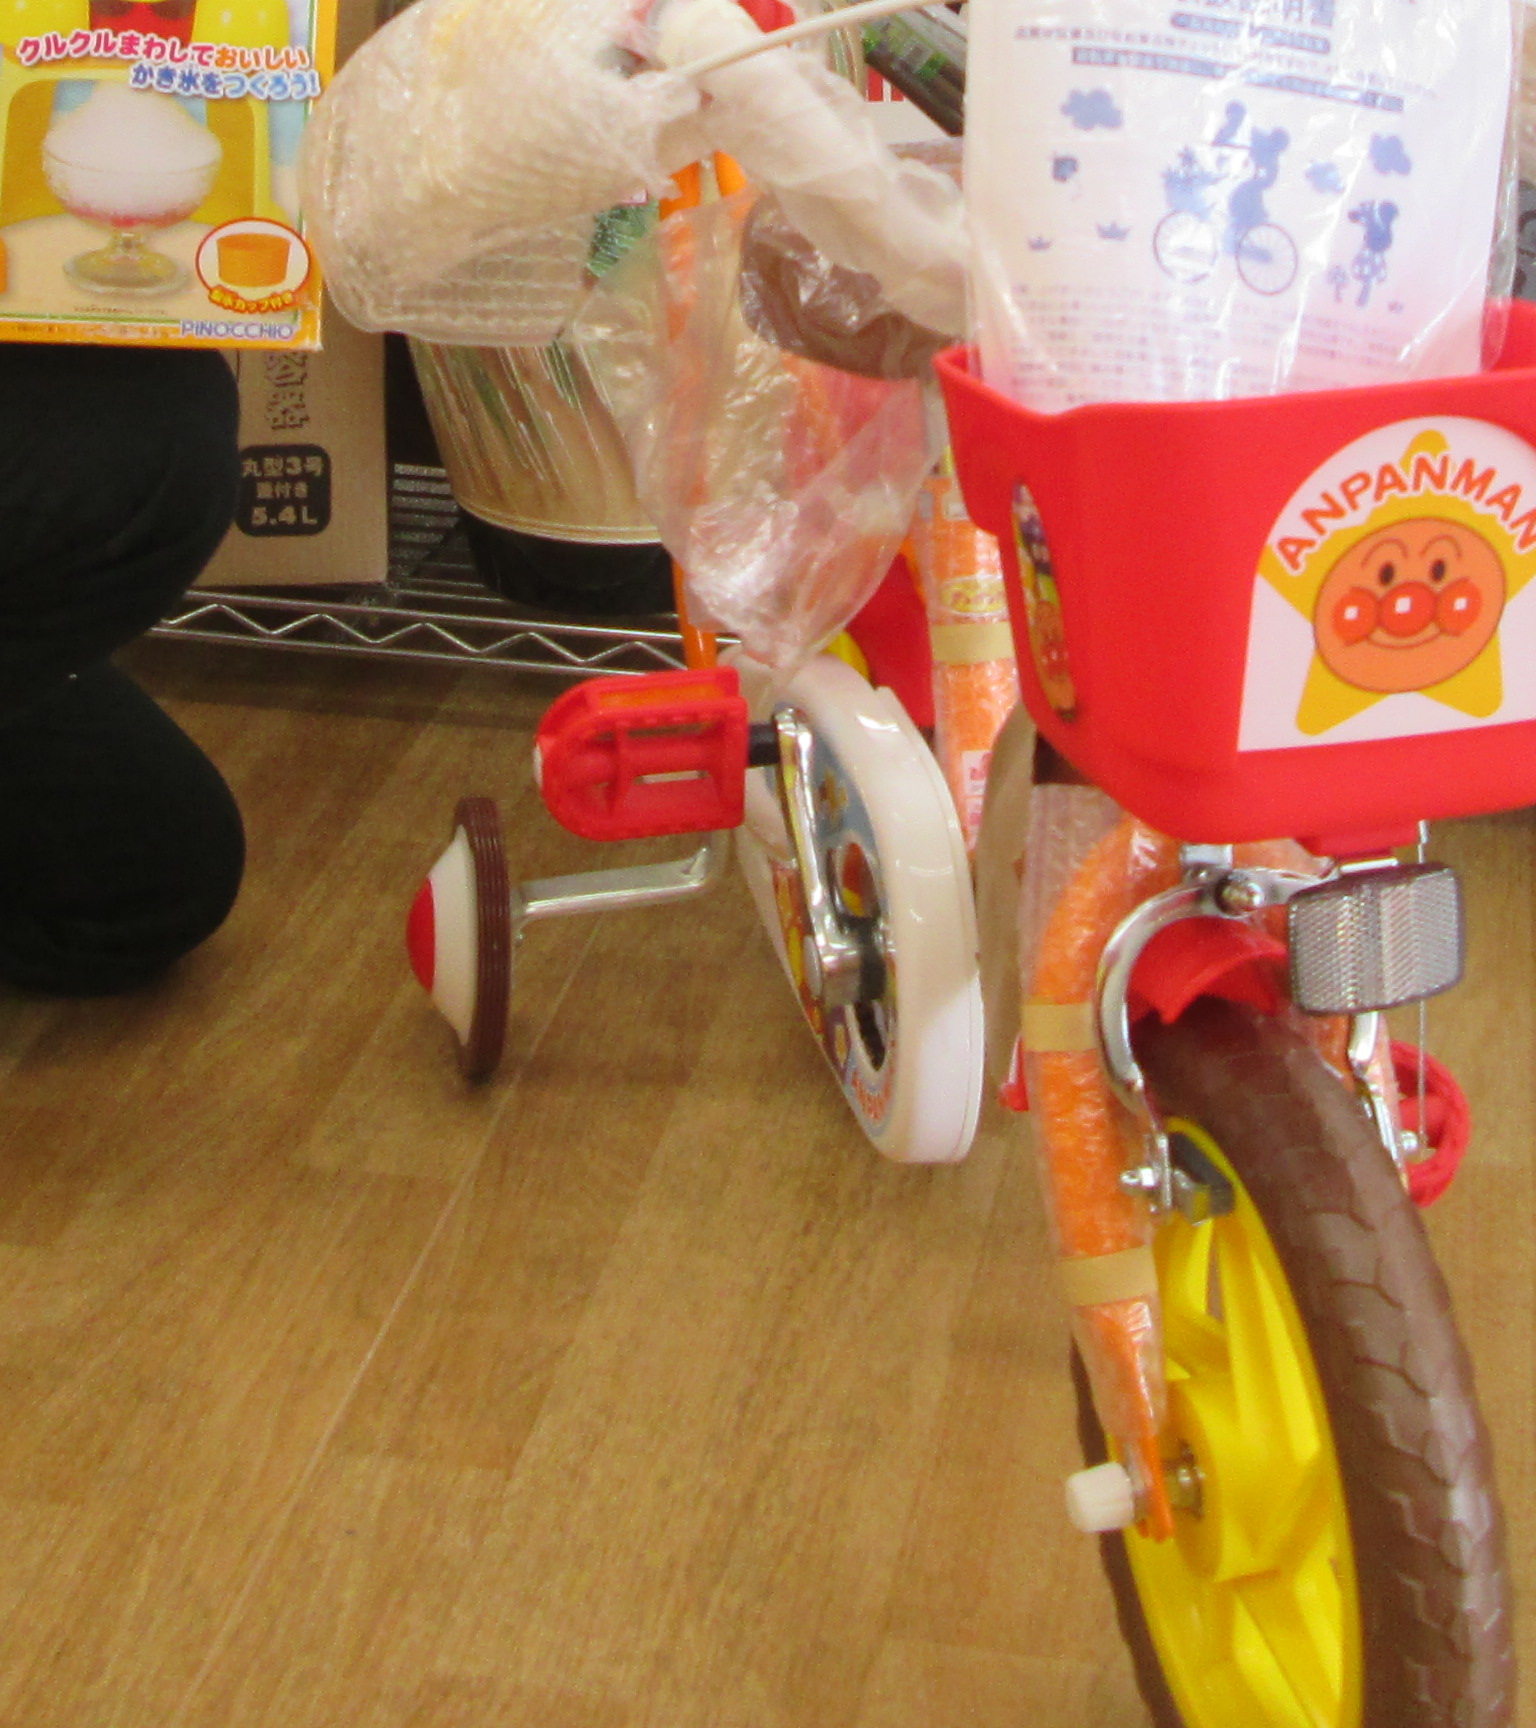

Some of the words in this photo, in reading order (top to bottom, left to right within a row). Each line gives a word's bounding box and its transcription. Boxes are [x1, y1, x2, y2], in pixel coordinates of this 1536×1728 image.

[18, 30, 309, 70] クルクルまわしておいしい
[132, 63, 320, 99] かき氷をつくろう!
